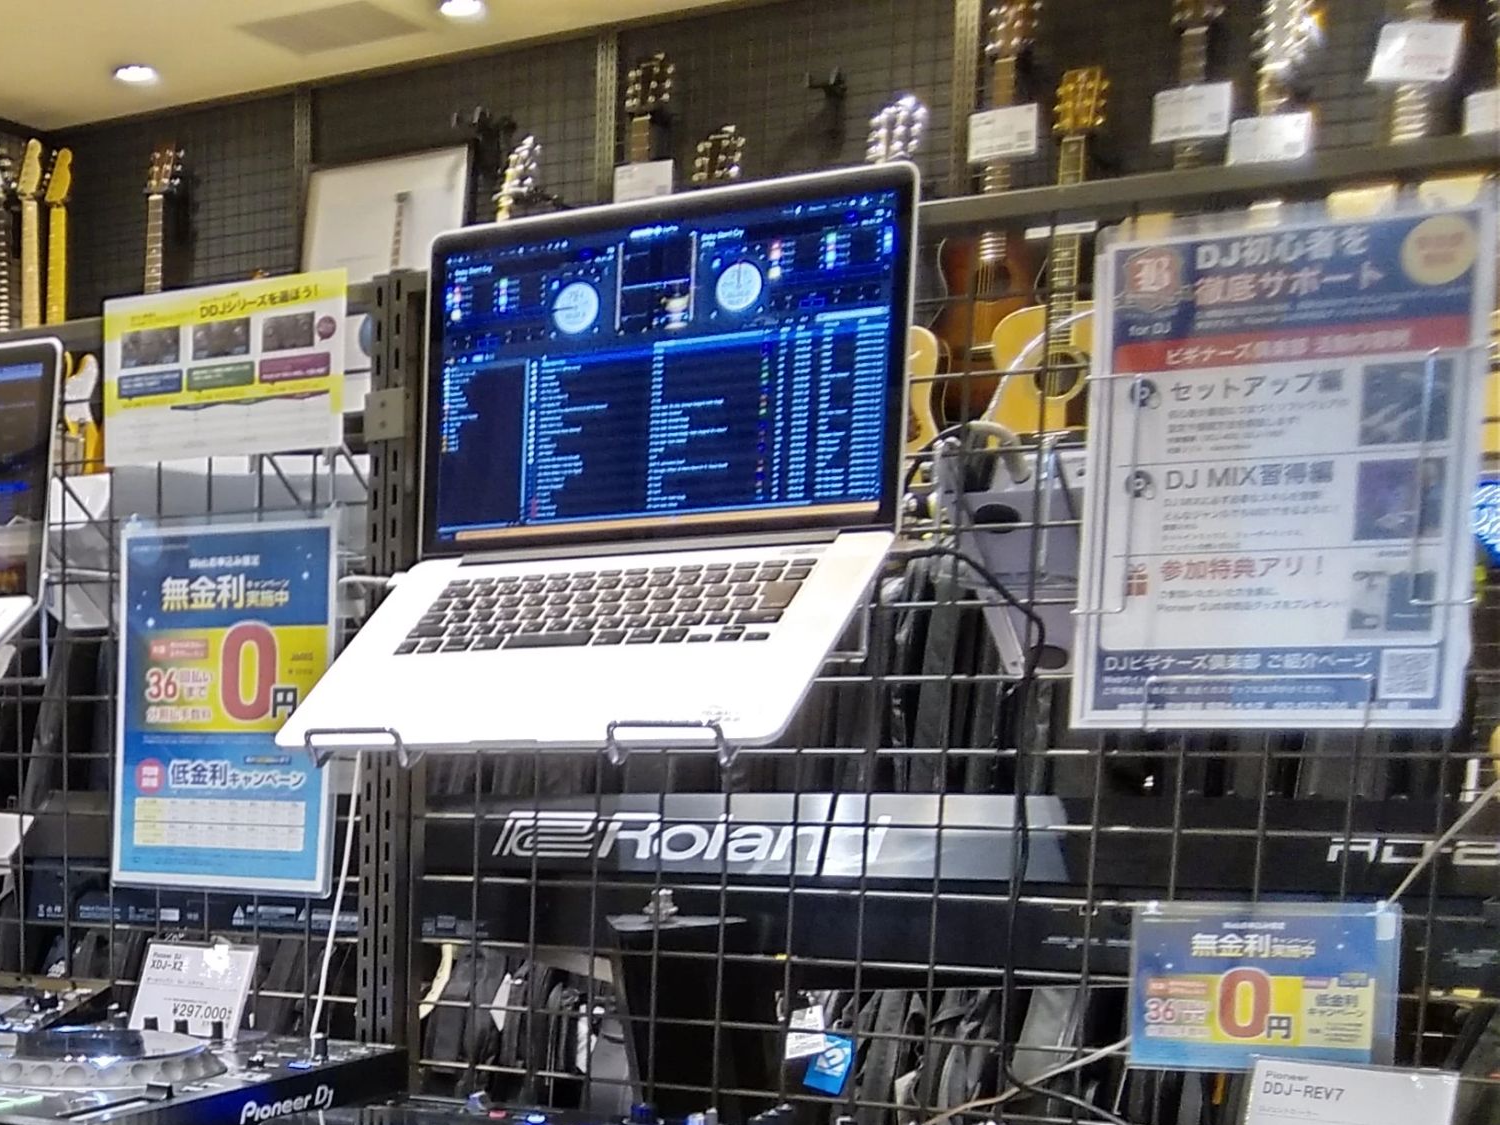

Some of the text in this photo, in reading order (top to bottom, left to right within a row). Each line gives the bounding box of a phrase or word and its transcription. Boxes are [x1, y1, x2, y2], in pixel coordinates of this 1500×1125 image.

[1165, 470, 1198, 490] DJ
[1160, 555, 1325, 581] 参加特典アリ！
[161, 573, 246, 612] 無金利
[147, 669, 178, 700] 36
[221, 621, 277, 723] 0
[597, 811, 892, 864] Roland
[1191, 933, 1271, 958] 無金利
[173, 1003, 227, 1019] ¥297,000
[1145, 998, 1177, 1024] 36
[1218, 966, 1271, 1041] 0
[1266, 1015, 1292, 1039] 円
[1265, 1070, 1309, 1082] Pioneer
[1262, 1081, 1345, 1102] DDJ-REV7
[239, 1095, 311, 1125] Pioneer
